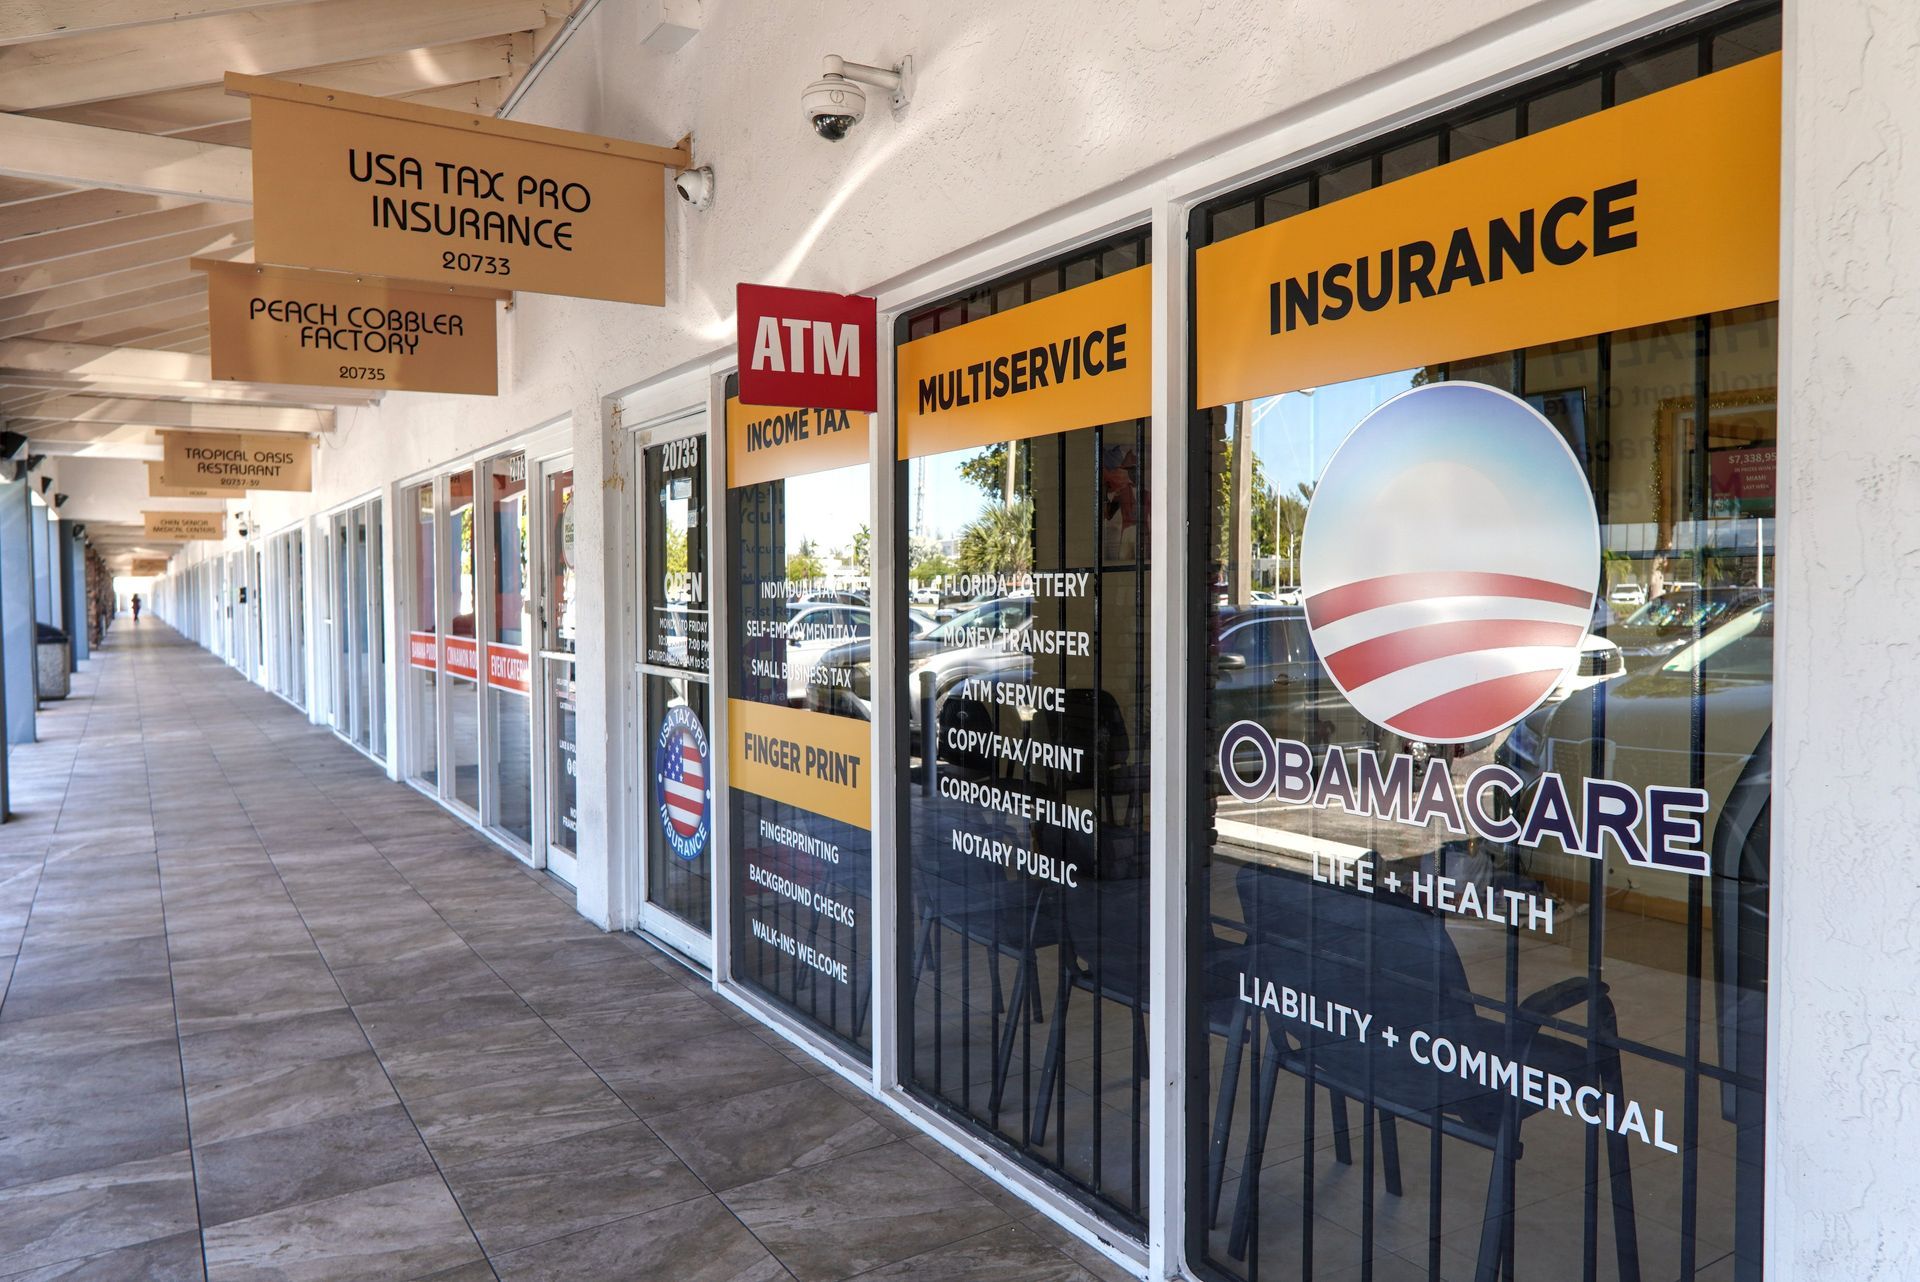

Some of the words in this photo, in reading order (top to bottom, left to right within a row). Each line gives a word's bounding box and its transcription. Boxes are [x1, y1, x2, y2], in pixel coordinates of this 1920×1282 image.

[349, 148, 423, 190] USA
[435, 161, 505, 202] TAX
[517, 175, 591, 214] PRO
[372, 195, 573, 252] INSURANCE
[442, 250, 511, 276] 20733
[1270, 178, 1638, 336] INSURANCE
[250, 297, 337, 327] PEACH
[347, 305, 464, 337] COBBLER
[300, 326, 420, 355] FACTORY
[751, 315, 860, 378] ATM
[339, 365, 386, 381] 20735
[918, 323, 1127, 416] MULTISERVICE
[747, 407, 809, 453] INCOME
[814, 407, 850, 437] TAX
[185, 447, 248, 462] TROPICAL
[254, 451, 294, 464] OASIS
[197, 462, 281, 477] RESTAURANT
[662, 436, 698, 473] 20733
[664, 571, 702, 603] OPEN
[761, 580, 815, 600] INDIVIDUAL
[816, 582, 838, 599] TAX
[944, 573, 1008, 597] FLORIDA
[1014, 572, 1089, 598] LOTTERY
[689, 620, 707, 633] FRIDAY
[689, 637, 700, 651] 7:00
[747, 619, 836, 642] SELF-EMPLOYMENT
[837, 624, 858, 643] TAX
[943, 626, 998, 651] MONEY
[1000, 628, 1089, 657] TRANSFER
[491, 654, 506, 678] EVENT
[751, 658, 780, 680] SMALL
[781, 661, 828, 687] BUSINESS
[830, 667, 851, 689] TAX
[961, 678, 992, 703] ATM
[996, 681, 1065, 713] SERVICE
[659, 718, 674, 750] USA
[673, 707, 690, 730] TAX
[691, 718, 708, 759] PRO
[947, 727, 1084, 774] COPY/FAX/PRINT
[744, 731, 801, 774] FINGER
[805, 744, 861, 789] PRINT
[940, 775, 1031, 820] CORPORATE
[1035, 798, 1094, 835] FILING
[660, 804, 707, 857] INSURANCE
[760, 818, 839, 865] FINGERPRINTING
[952, 829, 1013, 868] NOTARY
[1016, 847, 1078, 890] PUBLIC
[749, 863, 812, 908] BACKGROUND
[813, 892, 855, 929] CHECKS
[1311, 850, 1374, 894] LIFE
[1383, 871, 1402, 893] +
[1412, 870, 1554, 934] HEALTH
[752, 918, 796, 957] WALK-INS
[798, 941, 848, 985] WELCOME
[1238, 971, 1373, 1044] LIABILITY
[1381, 1025, 1400, 1049] +
[1409, 1030, 1679, 1154] COMMERCIAL
